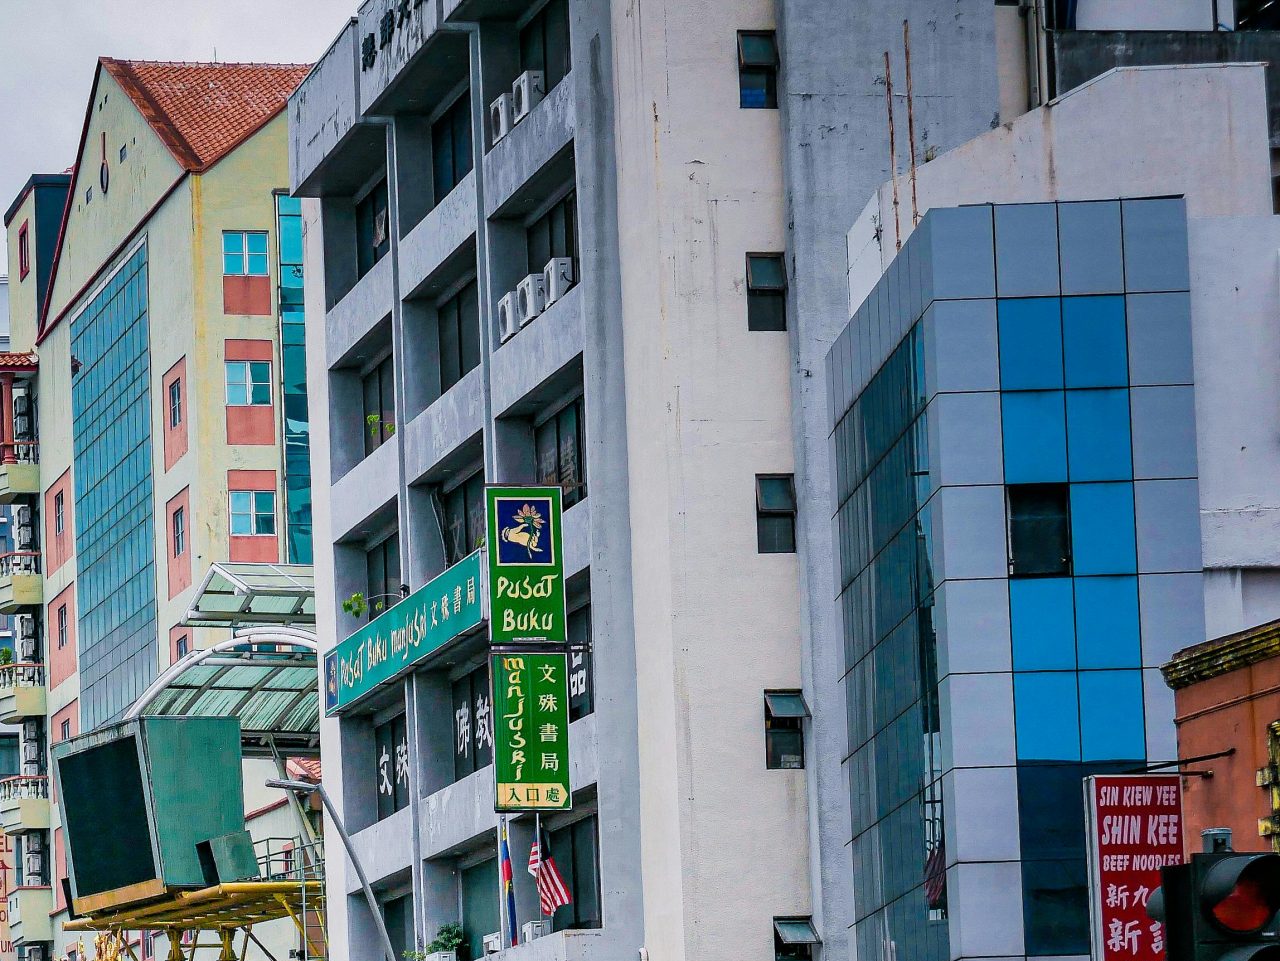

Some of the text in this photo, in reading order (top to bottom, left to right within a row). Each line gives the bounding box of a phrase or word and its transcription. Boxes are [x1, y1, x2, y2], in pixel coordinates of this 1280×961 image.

[537, 663, 560, 773] 文殊書局
[507, 785, 560, 804] 入口處
[1099, 785, 1177, 808] SIN KIEW YEE
[1101, 814, 1179, 846] SHIN KEE
[1103, 854, 1130, 872] BEEF
[1105, 882, 1150, 911] 新九
